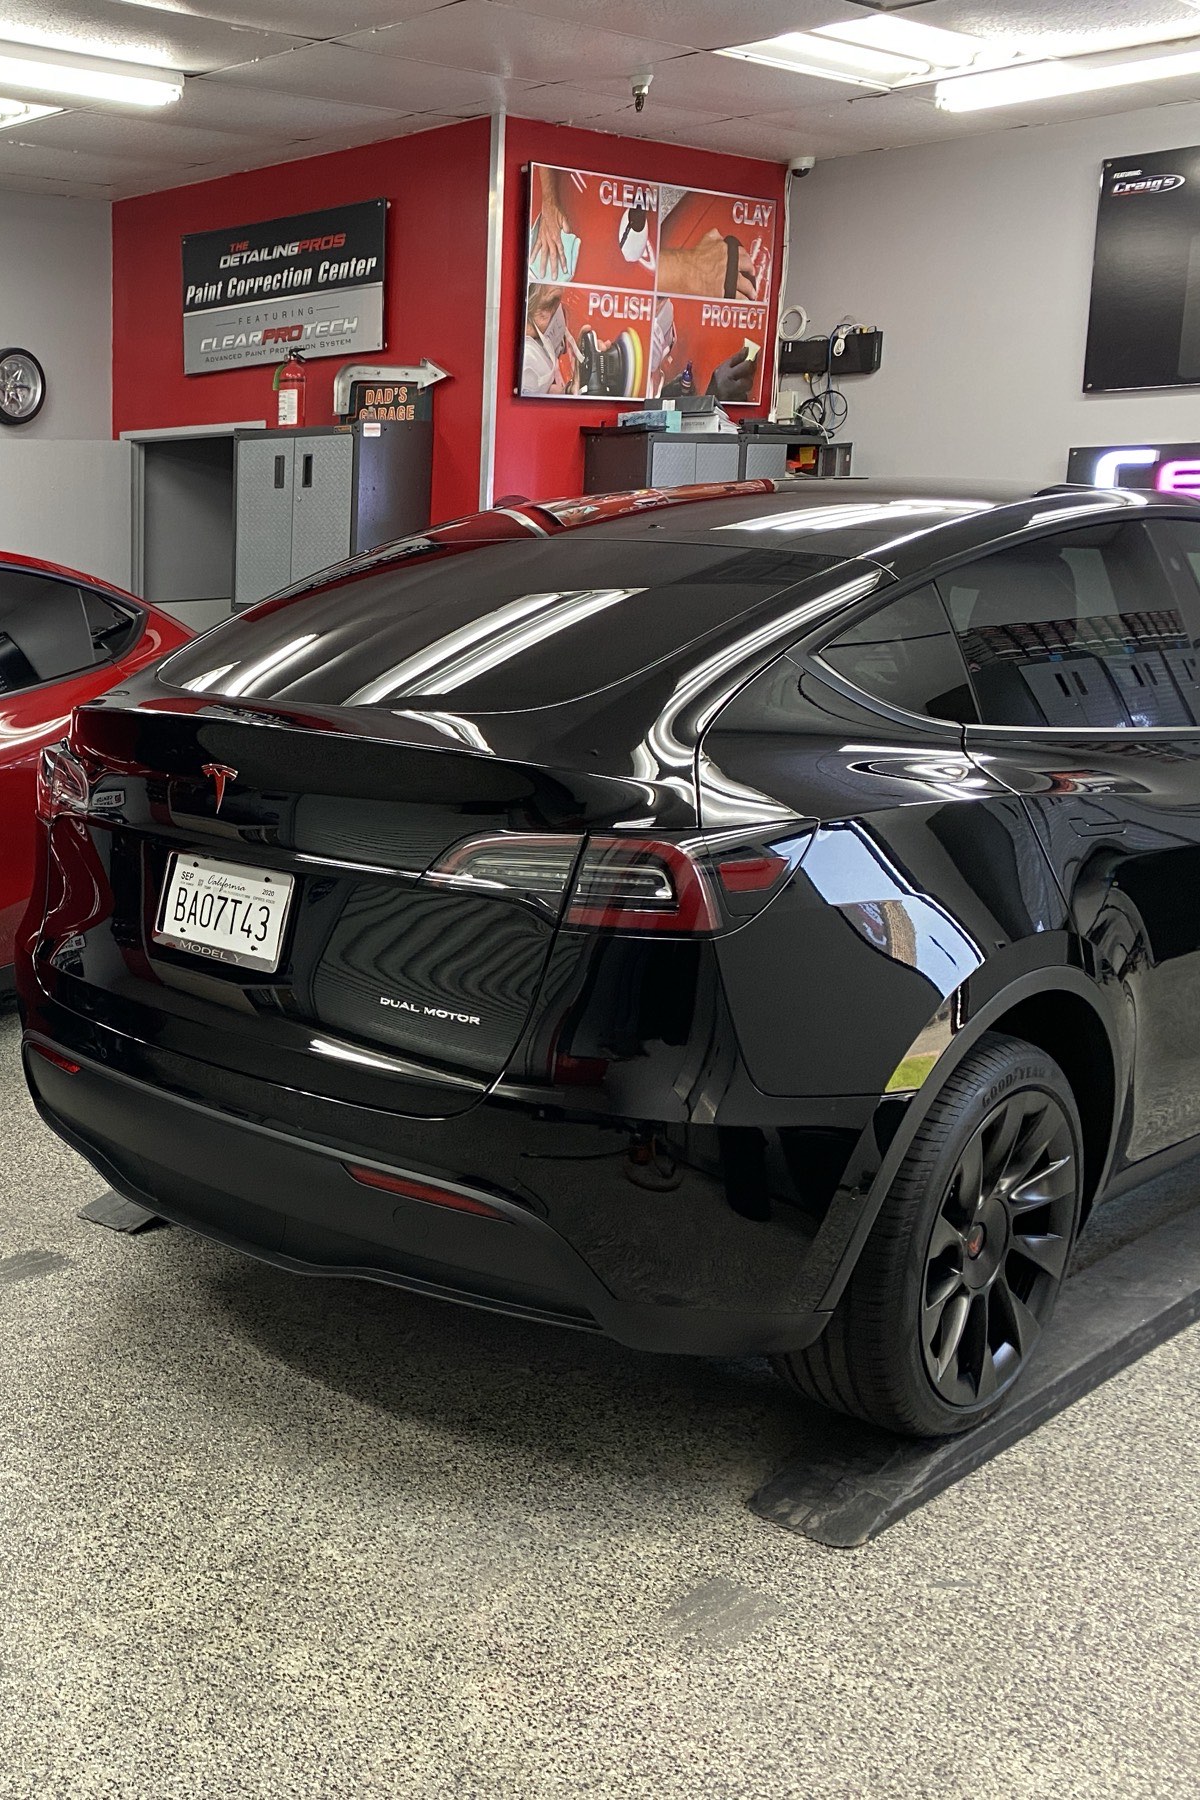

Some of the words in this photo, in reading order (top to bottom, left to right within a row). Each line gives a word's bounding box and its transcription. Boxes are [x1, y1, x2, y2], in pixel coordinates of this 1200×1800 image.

[599, 180, 659, 212] CLEAN
[1112, 177, 1176, 194] Craig's
[732, 201, 773, 228] CLAY
[219, 233, 347, 269] DETAILINGPROS
[229, 240, 249, 252] THE
[185, 278, 224, 306] Paint
[227, 266, 313, 299] Correction
[317, 256, 378, 283] Center
[238, 306, 315, 325] FEATURING
[587, 292, 652, 322] POLISH
[701, 304, 767, 330] PROTECT
[200, 315, 359, 354] CLEARPROTECH
[365, 386, 408, 406] DAD'S
[180, 870, 195, 881] SEP
[207, 874, 247, 893] California
[261, 888, 275, 897] 2020
[173, 886, 271, 942] BA07T43
[179, 939, 229, 960] MODEL
[233, 953, 244, 964] Y
[379, 996, 420, 1013] DUAL
[423, 1006, 481, 1025] MOTOR
